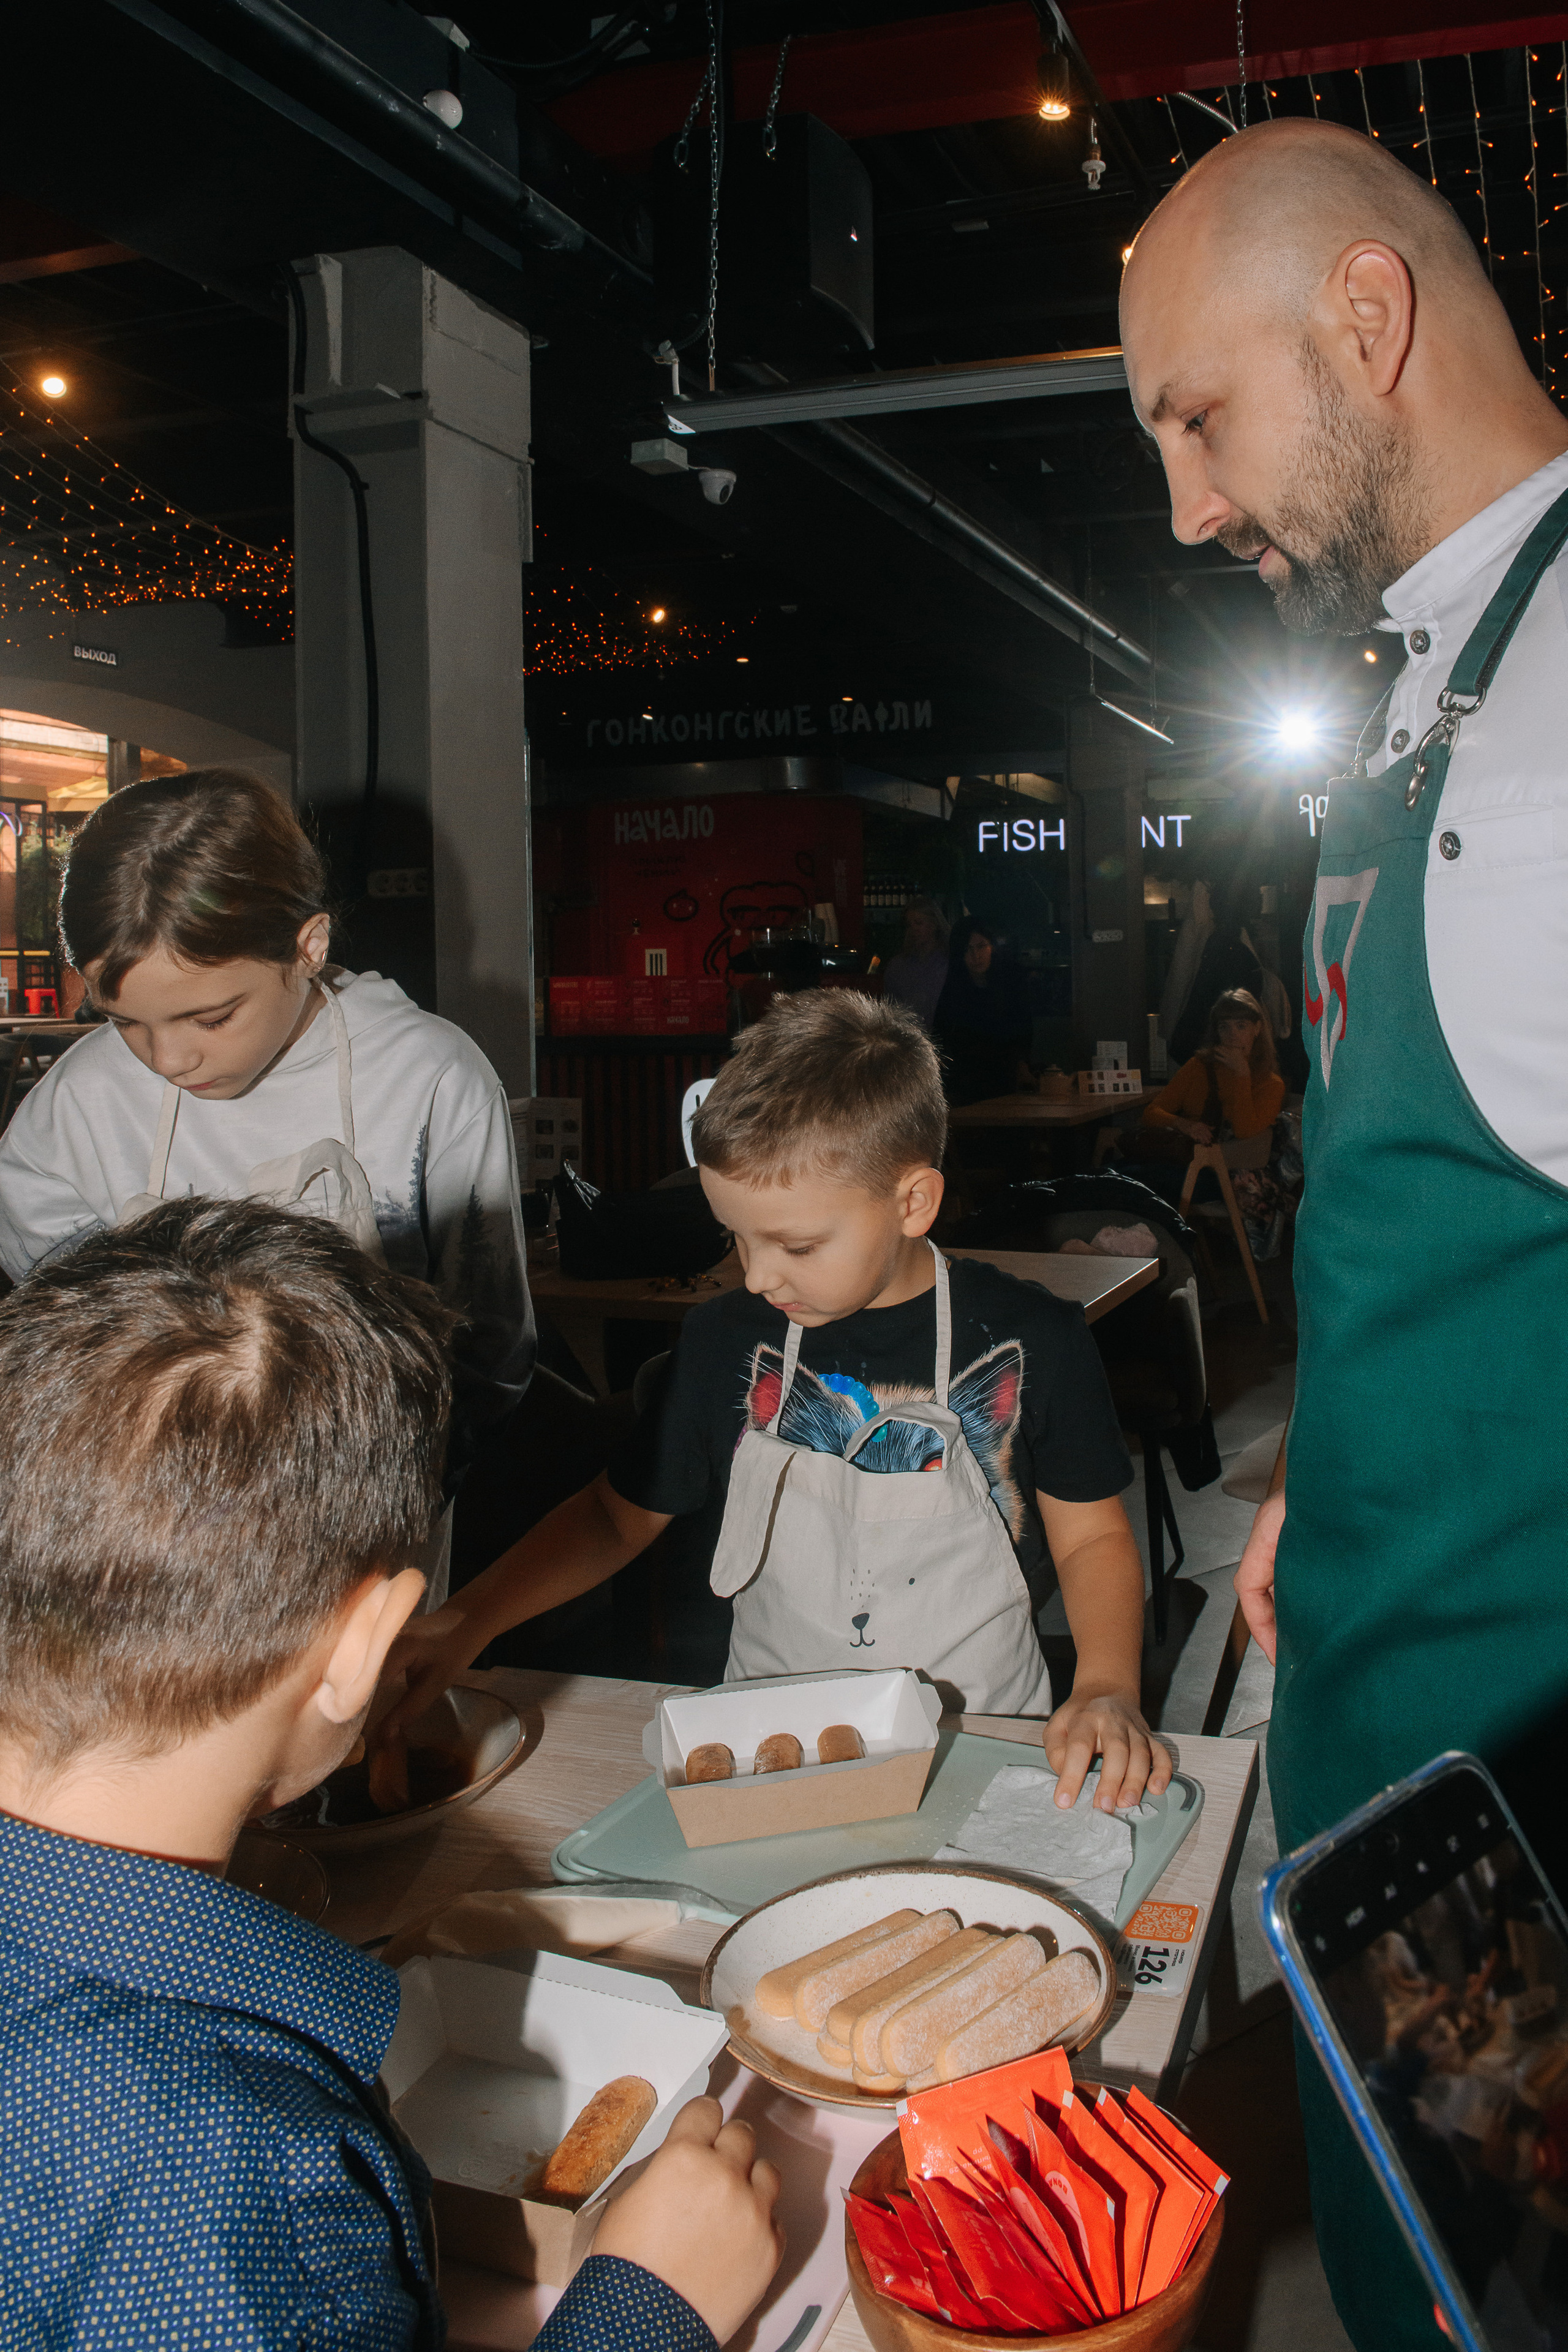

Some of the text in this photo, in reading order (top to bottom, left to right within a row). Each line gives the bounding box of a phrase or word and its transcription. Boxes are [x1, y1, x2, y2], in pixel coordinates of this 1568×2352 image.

[74, 646, 116, 666] ВЫХОД
[587, 699, 932, 747] ГОНКОНГСКИЕ ВАФЛИ
[979, 818, 1065, 853] FISH
[1134, 1945, 1170, 1985] 126
